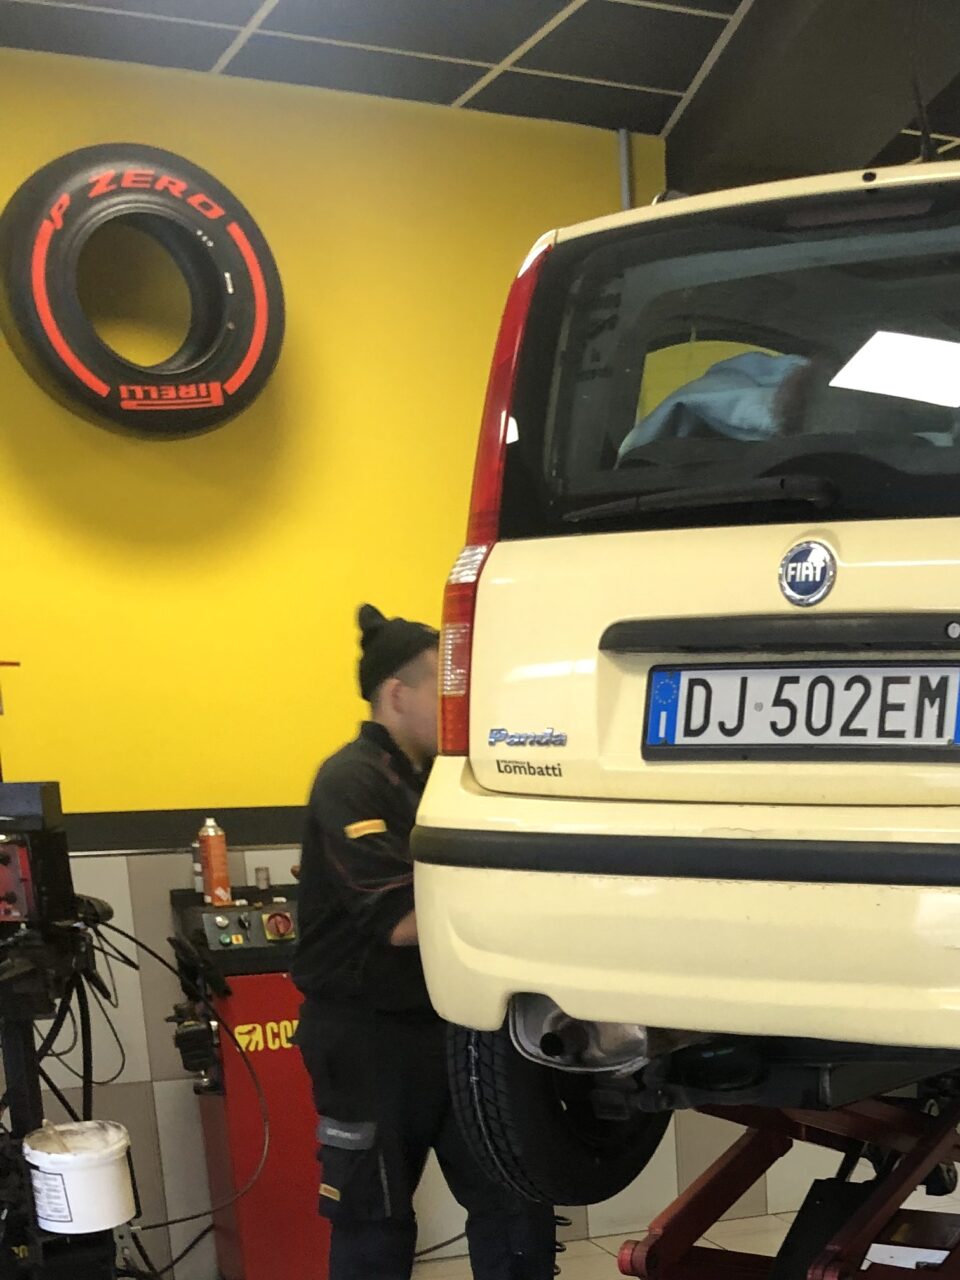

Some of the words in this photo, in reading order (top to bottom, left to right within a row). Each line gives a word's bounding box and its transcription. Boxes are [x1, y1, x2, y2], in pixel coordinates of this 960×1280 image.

[49, 192, 71, 230] P
[87, 168, 226, 220] ZERO
[119, 381, 224, 411] PIRELLI
[788, 562, 825, 582] FIAT
[682, 676, 747, 738] DJ
[769, 674, 952, 739] 502EM
[488, 727, 568, 747] Panda
[496, 758, 563, 777] Lombatti
